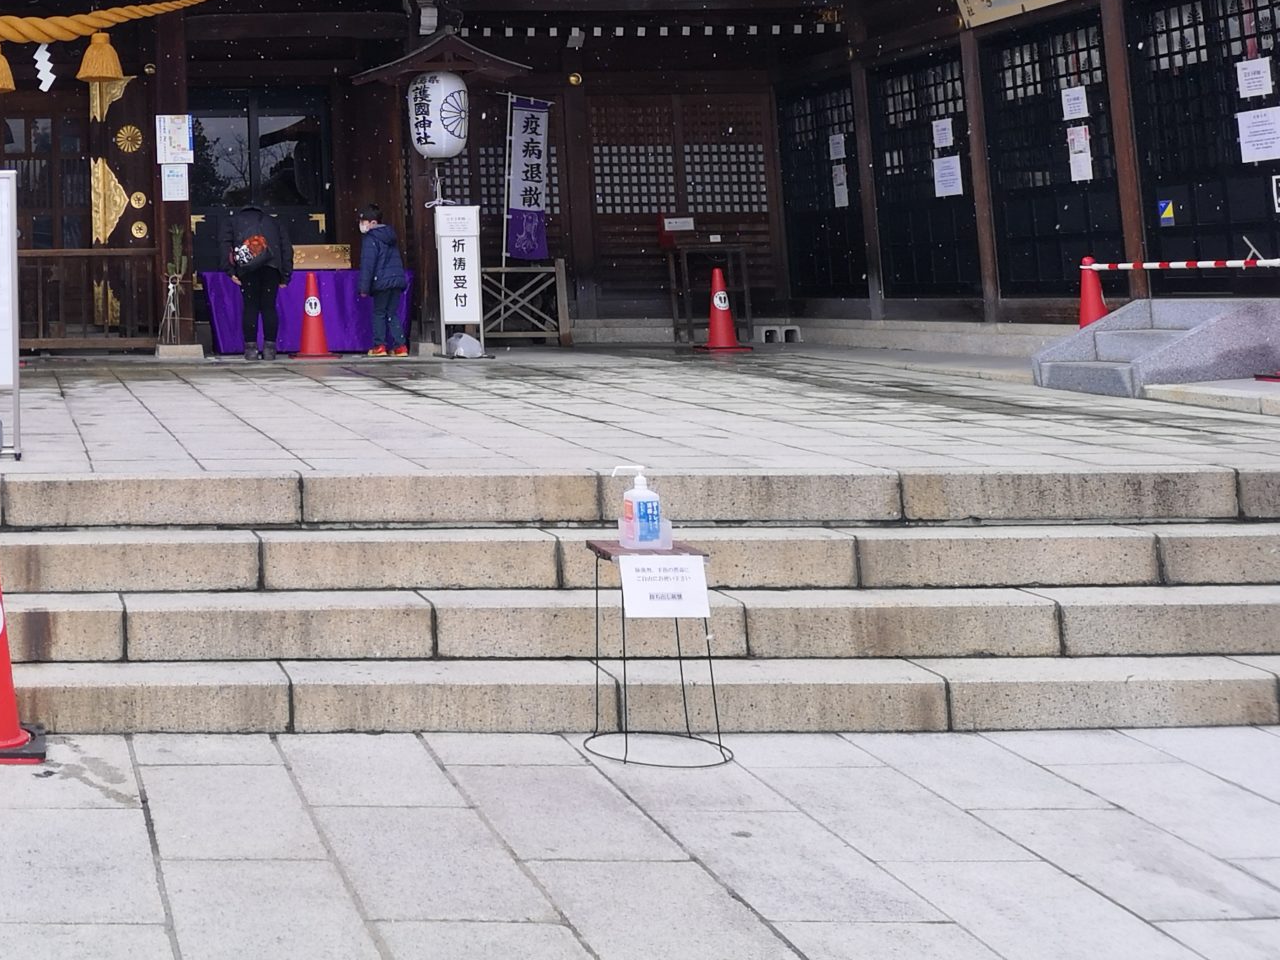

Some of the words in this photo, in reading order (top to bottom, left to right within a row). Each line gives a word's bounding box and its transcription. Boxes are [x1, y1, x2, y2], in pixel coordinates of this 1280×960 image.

[520, 113, 543, 208] 疫病退散
[452, 238, 468, 308] 祈祷受付
